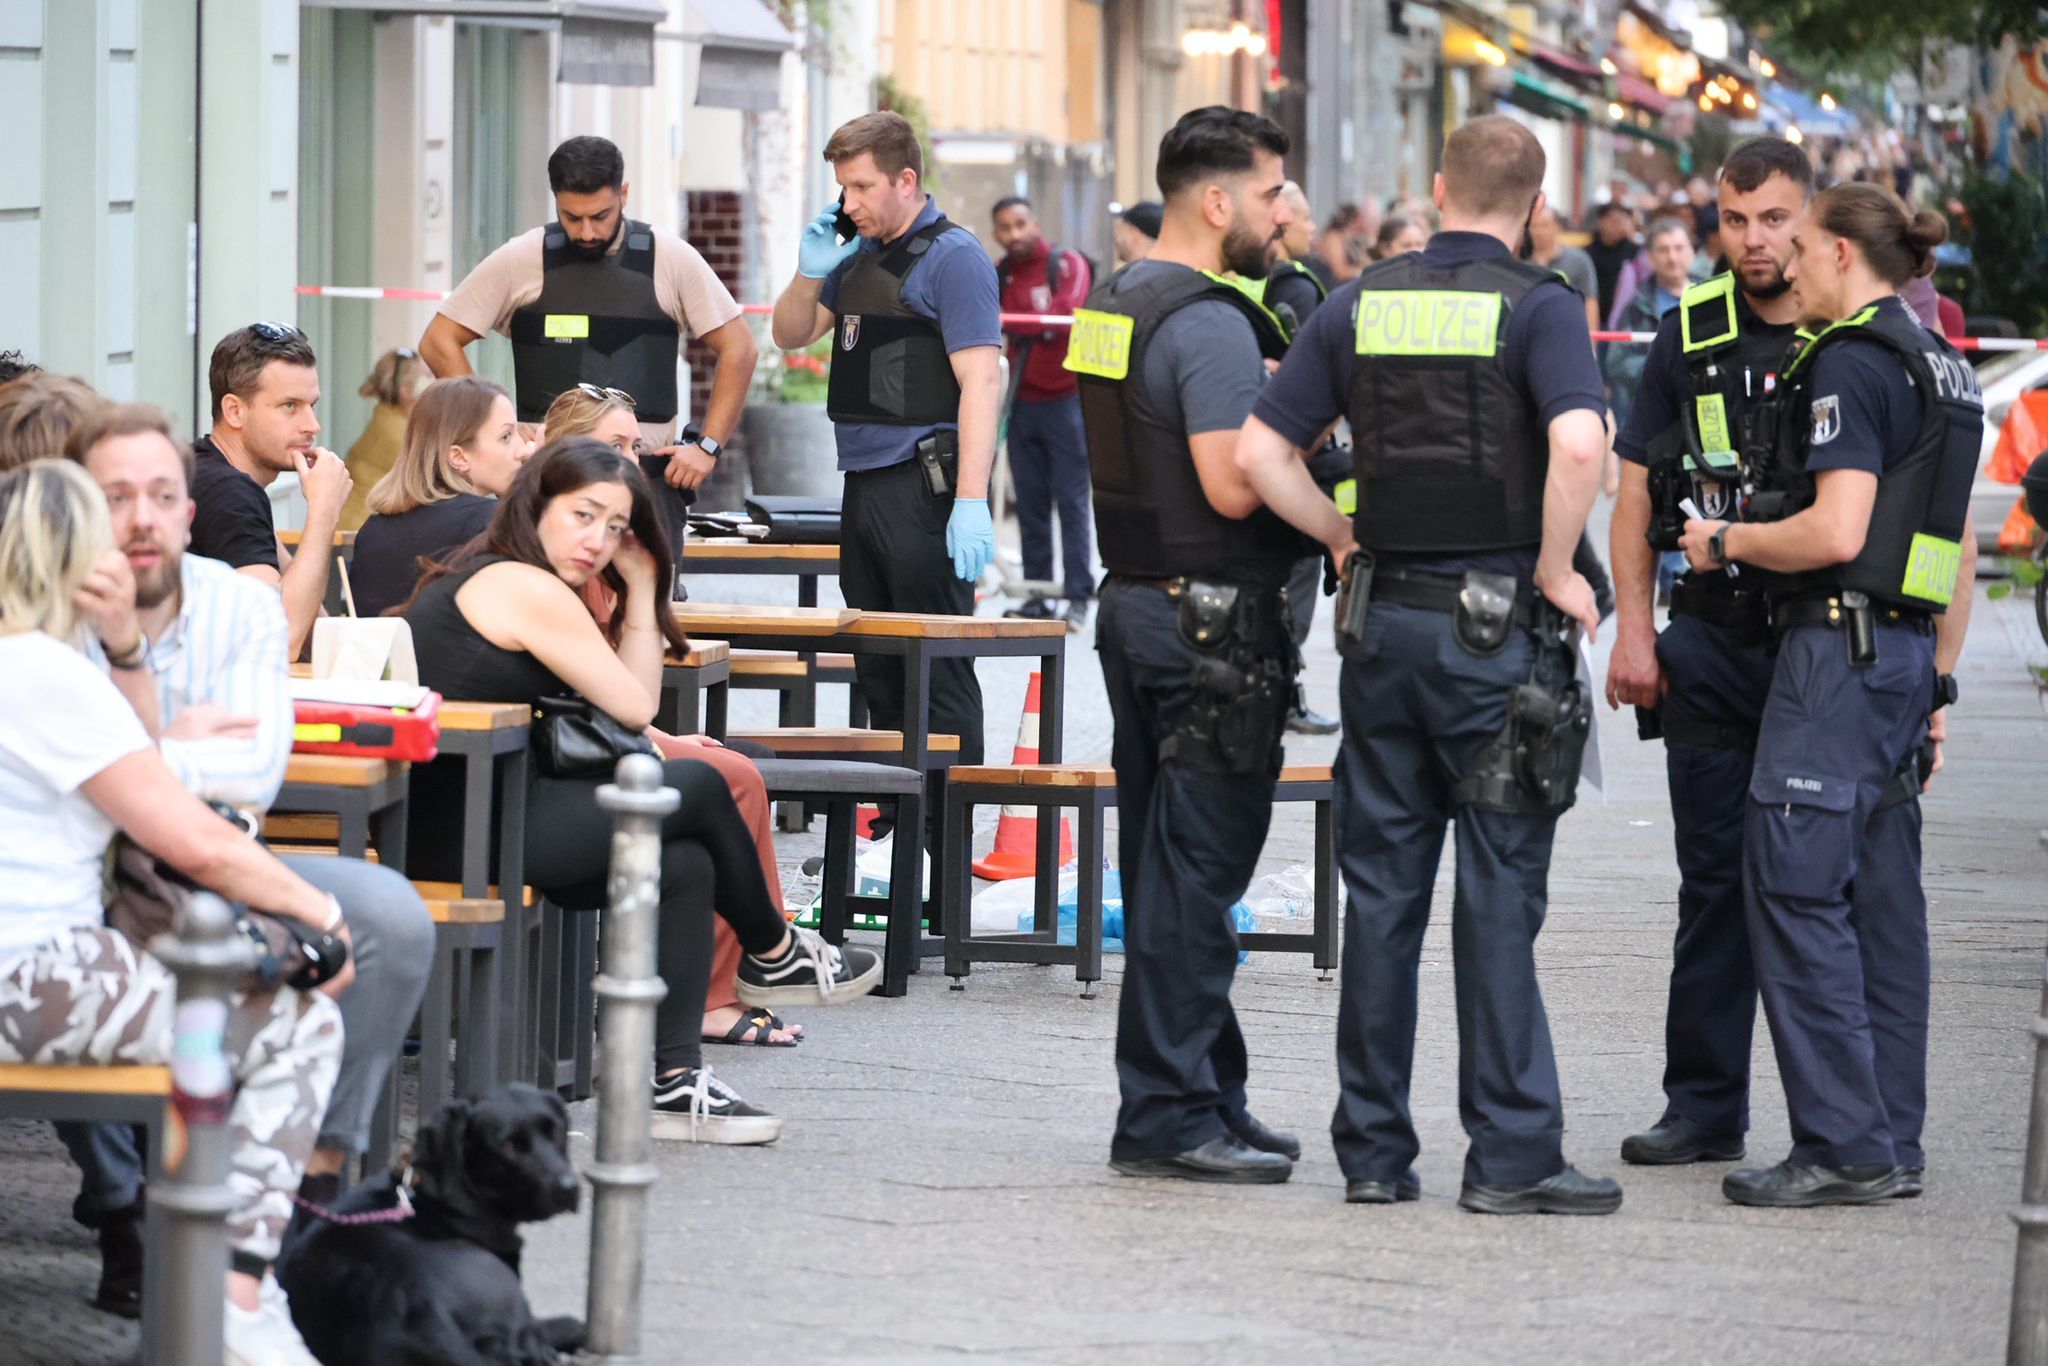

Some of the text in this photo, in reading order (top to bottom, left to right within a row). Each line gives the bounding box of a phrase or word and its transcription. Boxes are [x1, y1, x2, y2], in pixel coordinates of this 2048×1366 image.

[1071, 318, 1128, 369] POLIZEI
[1361, 298, 1495, 351] POLIZEI
[1700, 400, 1725, 452] POLIZEI
[1786, 777, 1822, 792] POLIZEI
